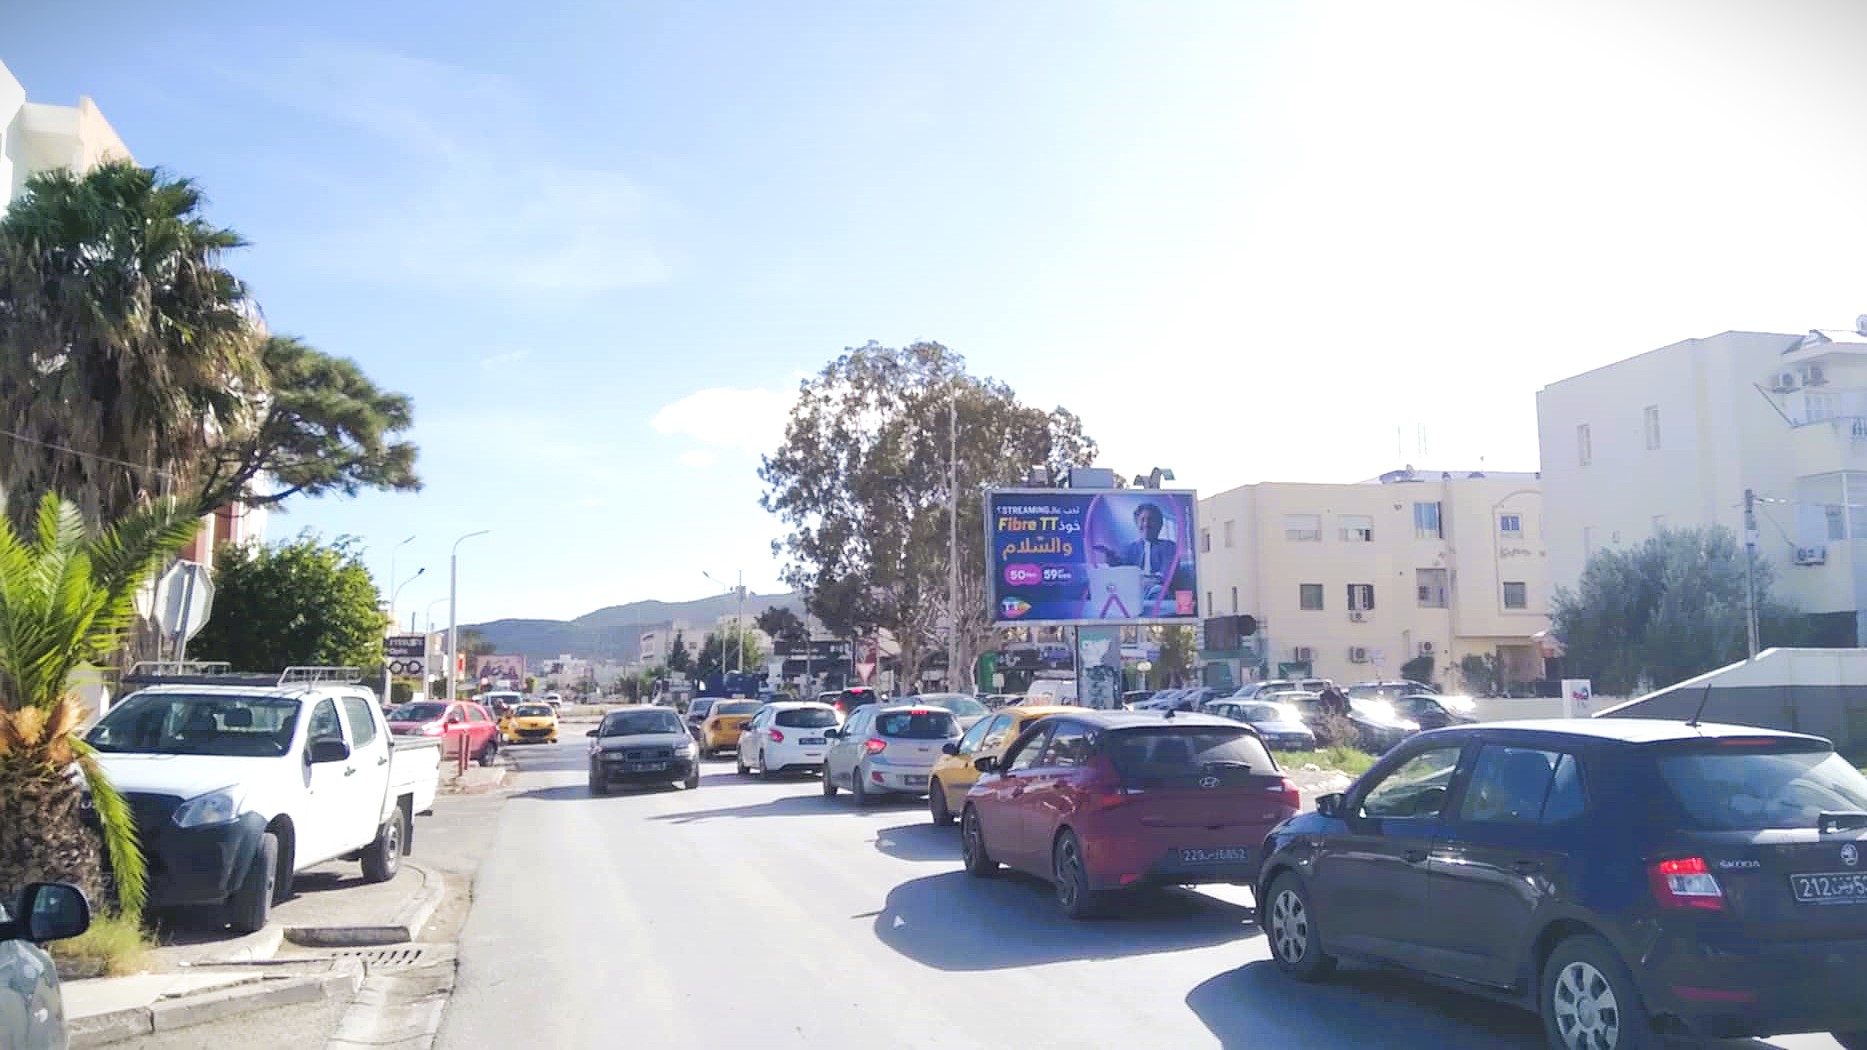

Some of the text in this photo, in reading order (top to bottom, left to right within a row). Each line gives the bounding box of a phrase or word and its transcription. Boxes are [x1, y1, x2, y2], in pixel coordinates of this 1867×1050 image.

[998, 516, 1037, 532] Fibre
[1039, 516, 1059, 531] TT
[1009, 569, 1026, 580] 50
[1043, 568, 1058, 580] 59
